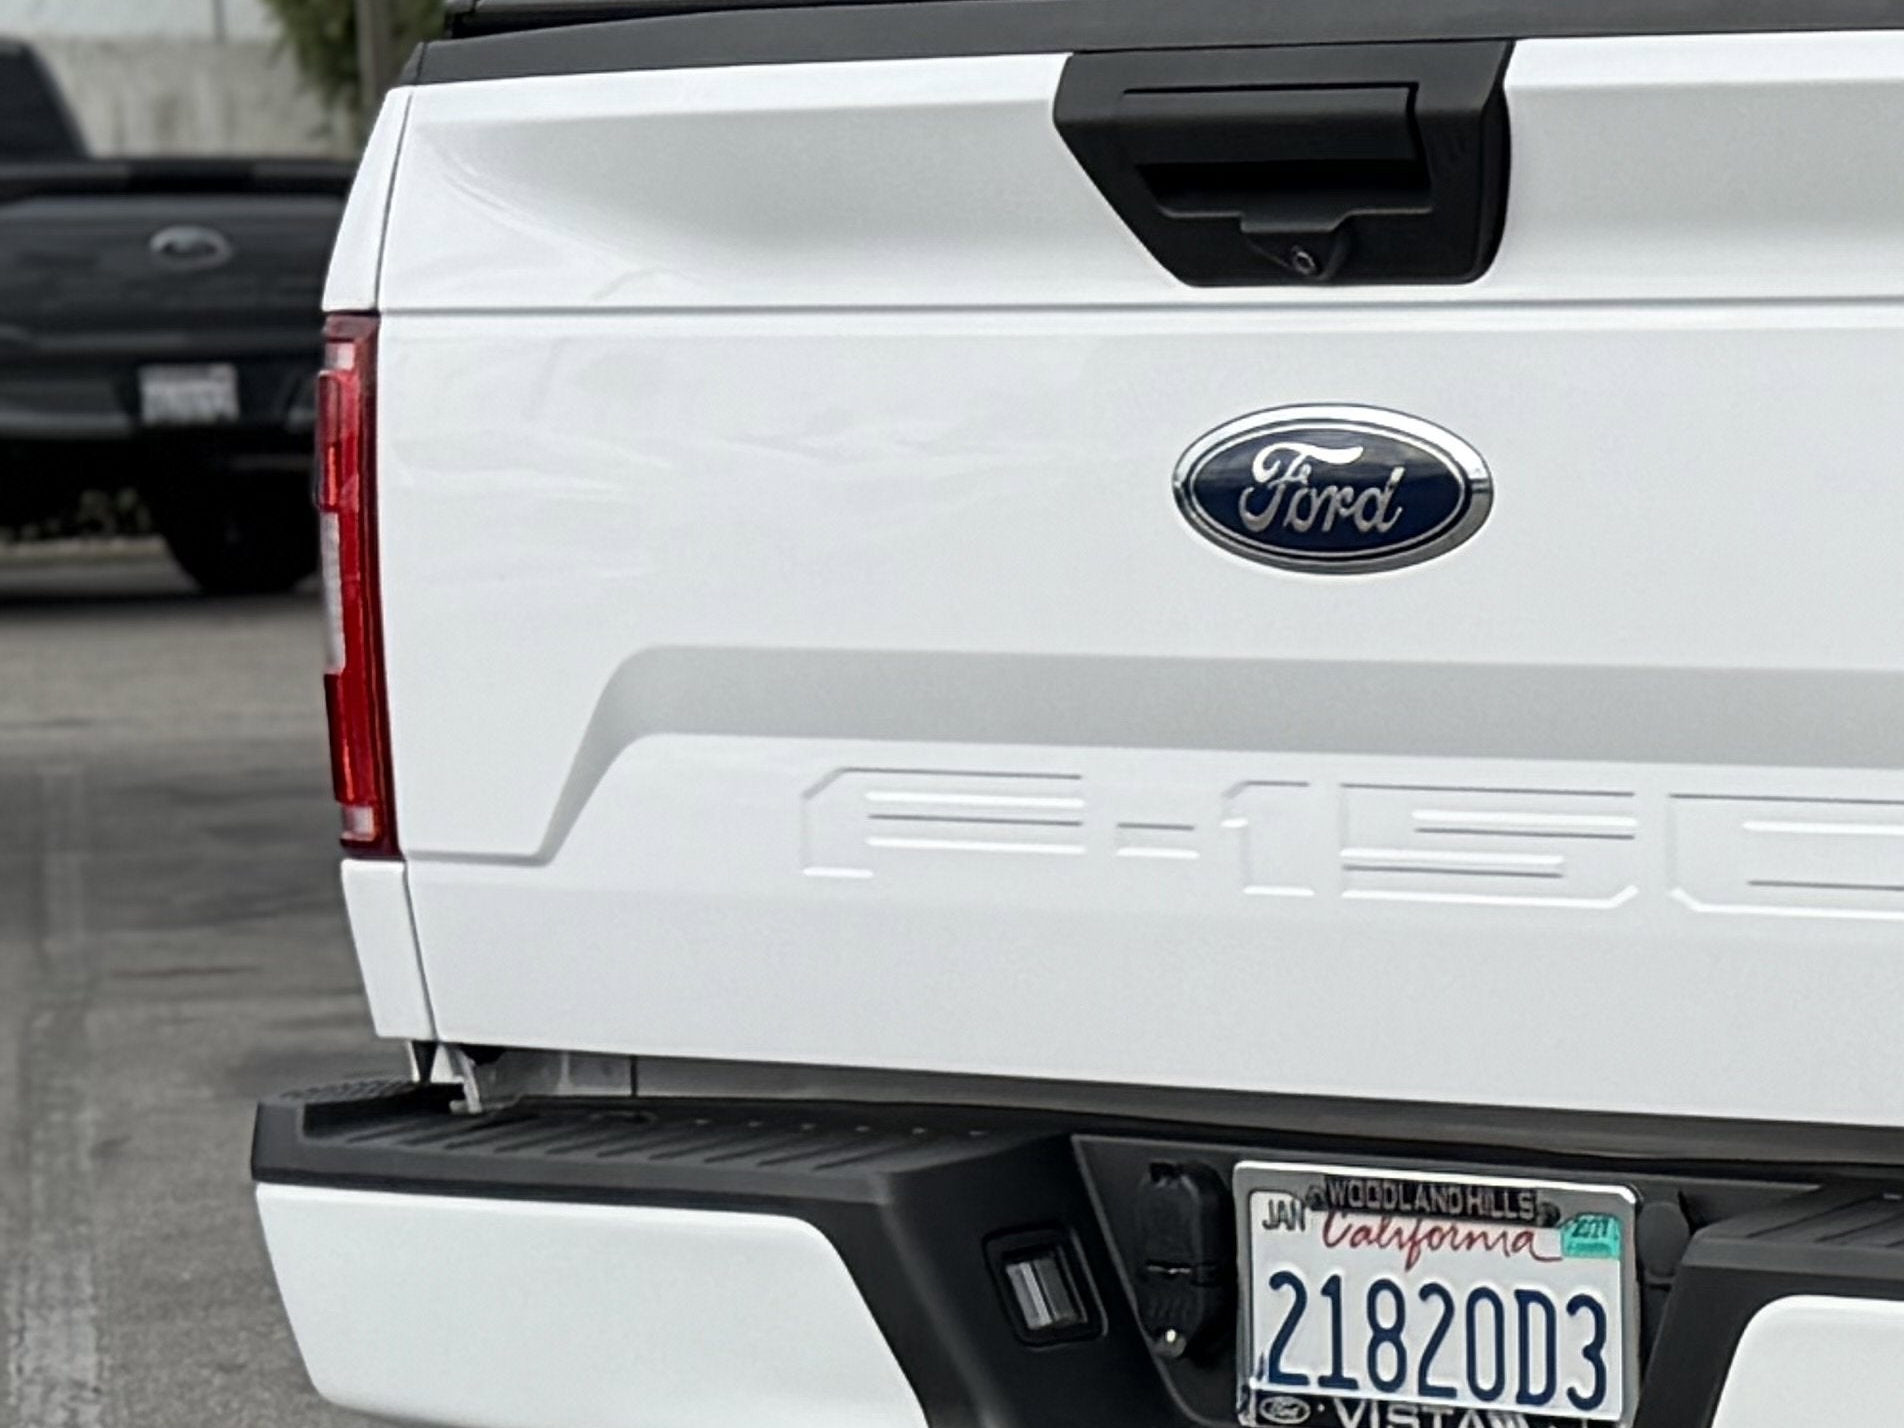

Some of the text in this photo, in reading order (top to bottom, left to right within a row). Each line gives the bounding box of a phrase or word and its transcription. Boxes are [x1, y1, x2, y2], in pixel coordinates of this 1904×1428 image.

[1238, 441, 1406, 534] Ford
[1327, 1177, 1537, 1221] WOODLAND HILLS
[1322, 1209, 1564, 1271] California
[1267, 1270, 1608, 1412] 21820D3
